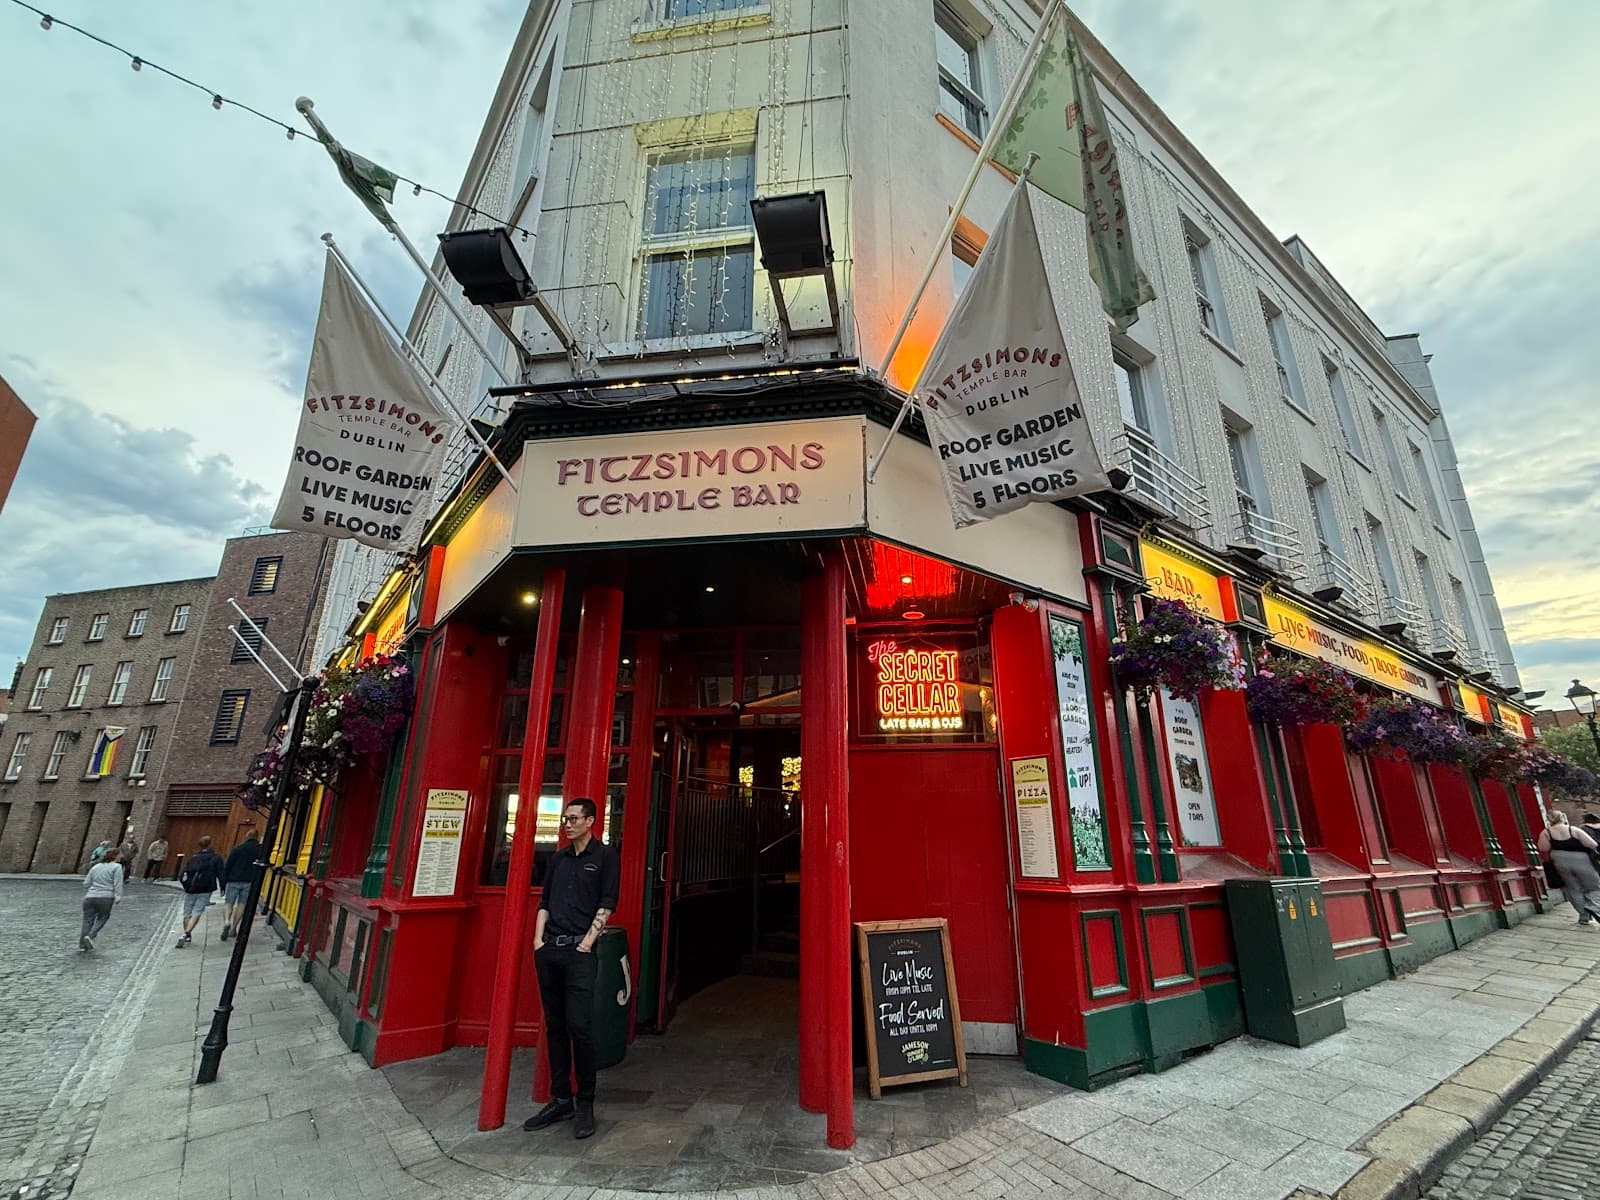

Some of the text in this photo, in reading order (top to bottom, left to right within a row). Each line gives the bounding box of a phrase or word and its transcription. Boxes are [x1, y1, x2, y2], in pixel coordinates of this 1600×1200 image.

[926, 347, 1061, 410] FITZSIMONS
[957, 369, 1027, 401] TEMPLE BAR
[966, 386, 1029, 416] DUBLIN
[306, 395, 444, 444] FITZSIMONS
[338, 415, 412, 438] TEMPLE BAR
[938, 403, 1082, 460] ROOF GARDEN
[340, 429, 405, 453] DUBLIN
[294, 446, 433, 491] ROOF GARDEN
[557, 442, 825, 485] FITZSIMONS
[959, 439, 1074, 482] LIVE MUSIC
[301, 477, 413, 515] LIVE MUSIC
[577, 482, 801, 516] TEMPLE BAR
[973, 469, 1078, 509] 5 FLOORS
[302, 506, 402, 541] 5 FLOORS
[1161, 567, 1195, 597] BAR
[867, 640, 897, 661] The
[1278, 614, 1305, 639] LIVE
[1341, 642, 1369, 665] FOOD
[879, 650, 958, 682] SECRET
[879, 682, 961, 714] CELLAR
[879, 718, 907, 730] LATE
[908, 717, 931, 729] BAR
[1017, 787, 1048, 798] PIZZA
[1079, 772, 1091, 788] UP!
[426, 820, 460, 829] STEW
[883, 959, 933, 986] Live Music
[879, 998, 945, 1029] Food Served
